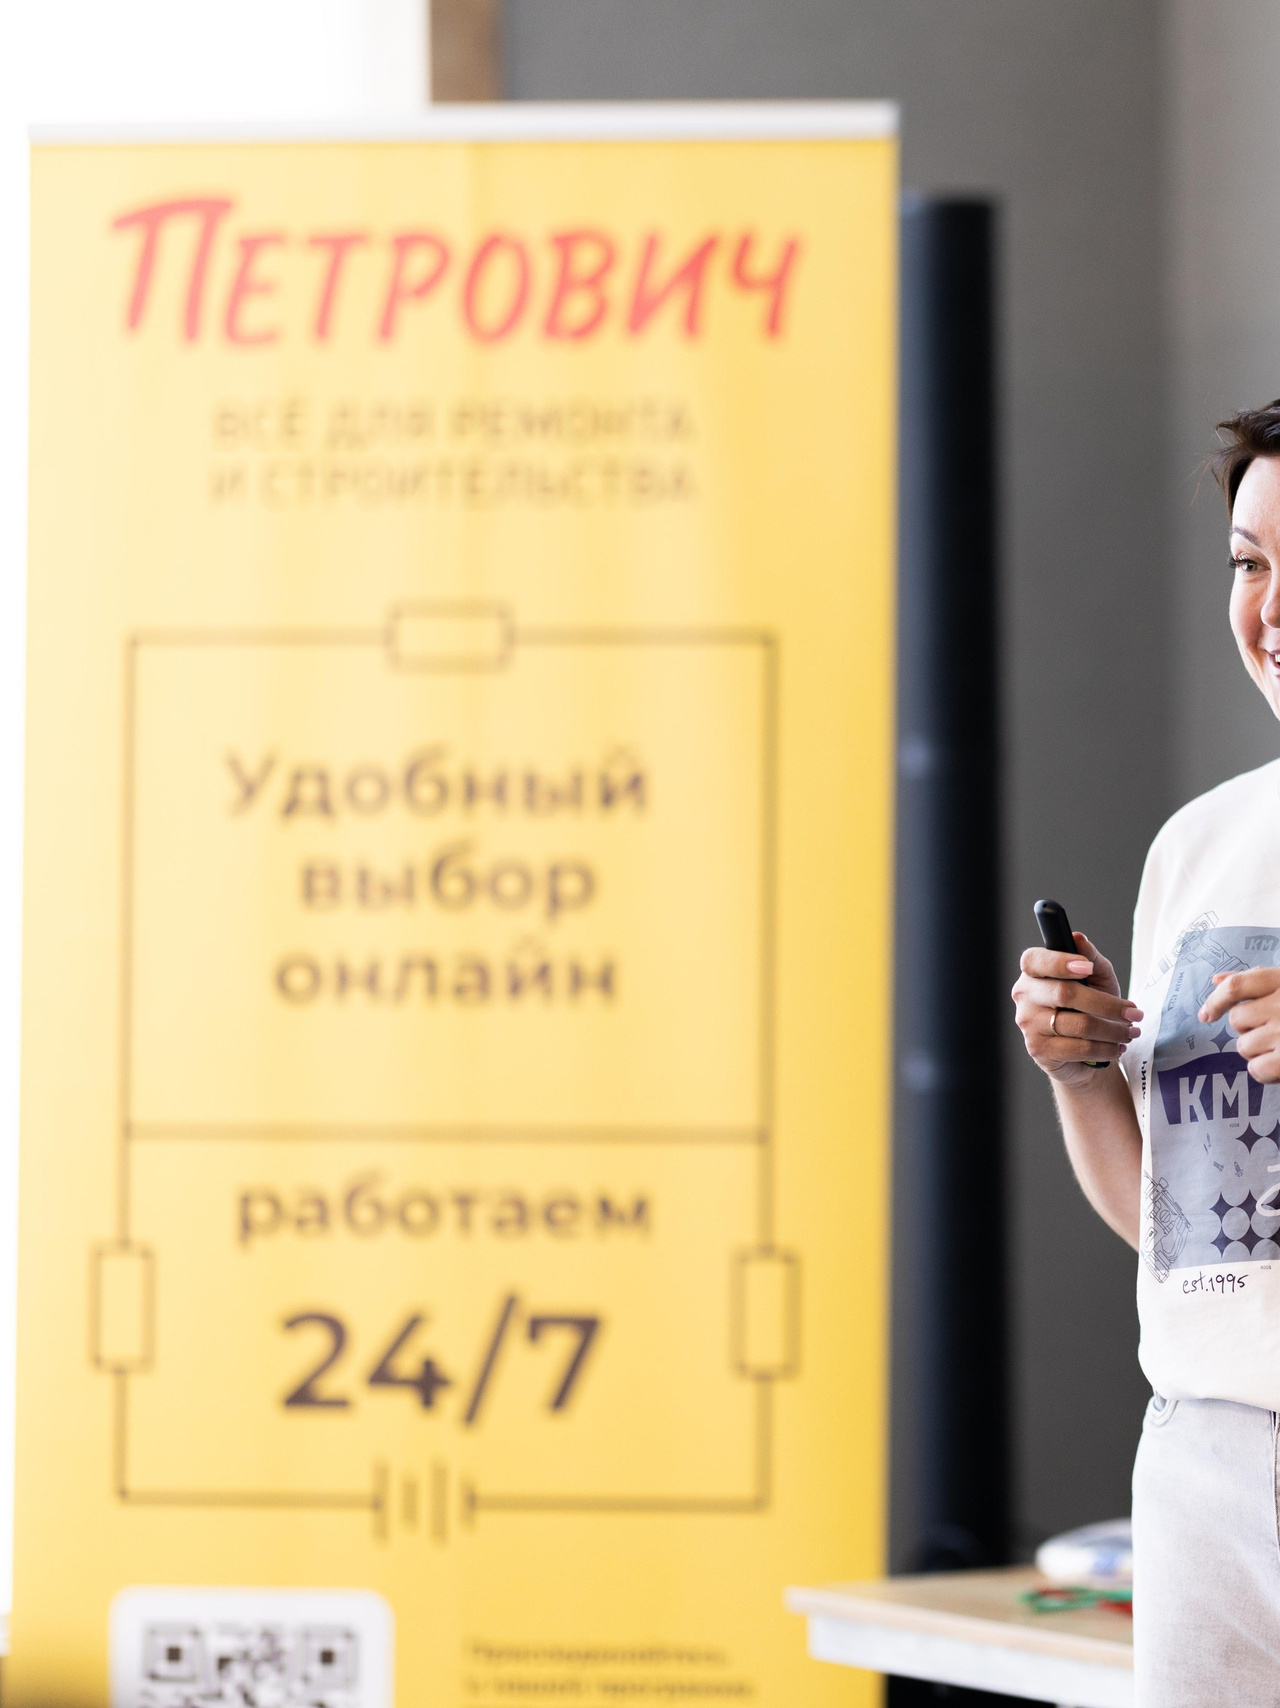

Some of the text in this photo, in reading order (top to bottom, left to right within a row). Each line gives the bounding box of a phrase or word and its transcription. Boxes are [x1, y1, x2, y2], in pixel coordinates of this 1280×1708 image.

[109, 194, 804, 347] ПЕТРОВИЧ
[449, 399, 697, 444] РЕМОНТА
[259, 459, 698, 508] СТРОИТЕЛЬСТВА
[225, 744, 650, 825] Удобный
[301, 839, 596, 924] выбор
[274, 935, 618, 1008] онлайн
[1179, 1071, 1250, 1124] KM
[239, 1169, 651, 1252] работаем
[1182, 1271, 1249, 1294] est.1995
[280, 1289, 602, 1428] 24/7
